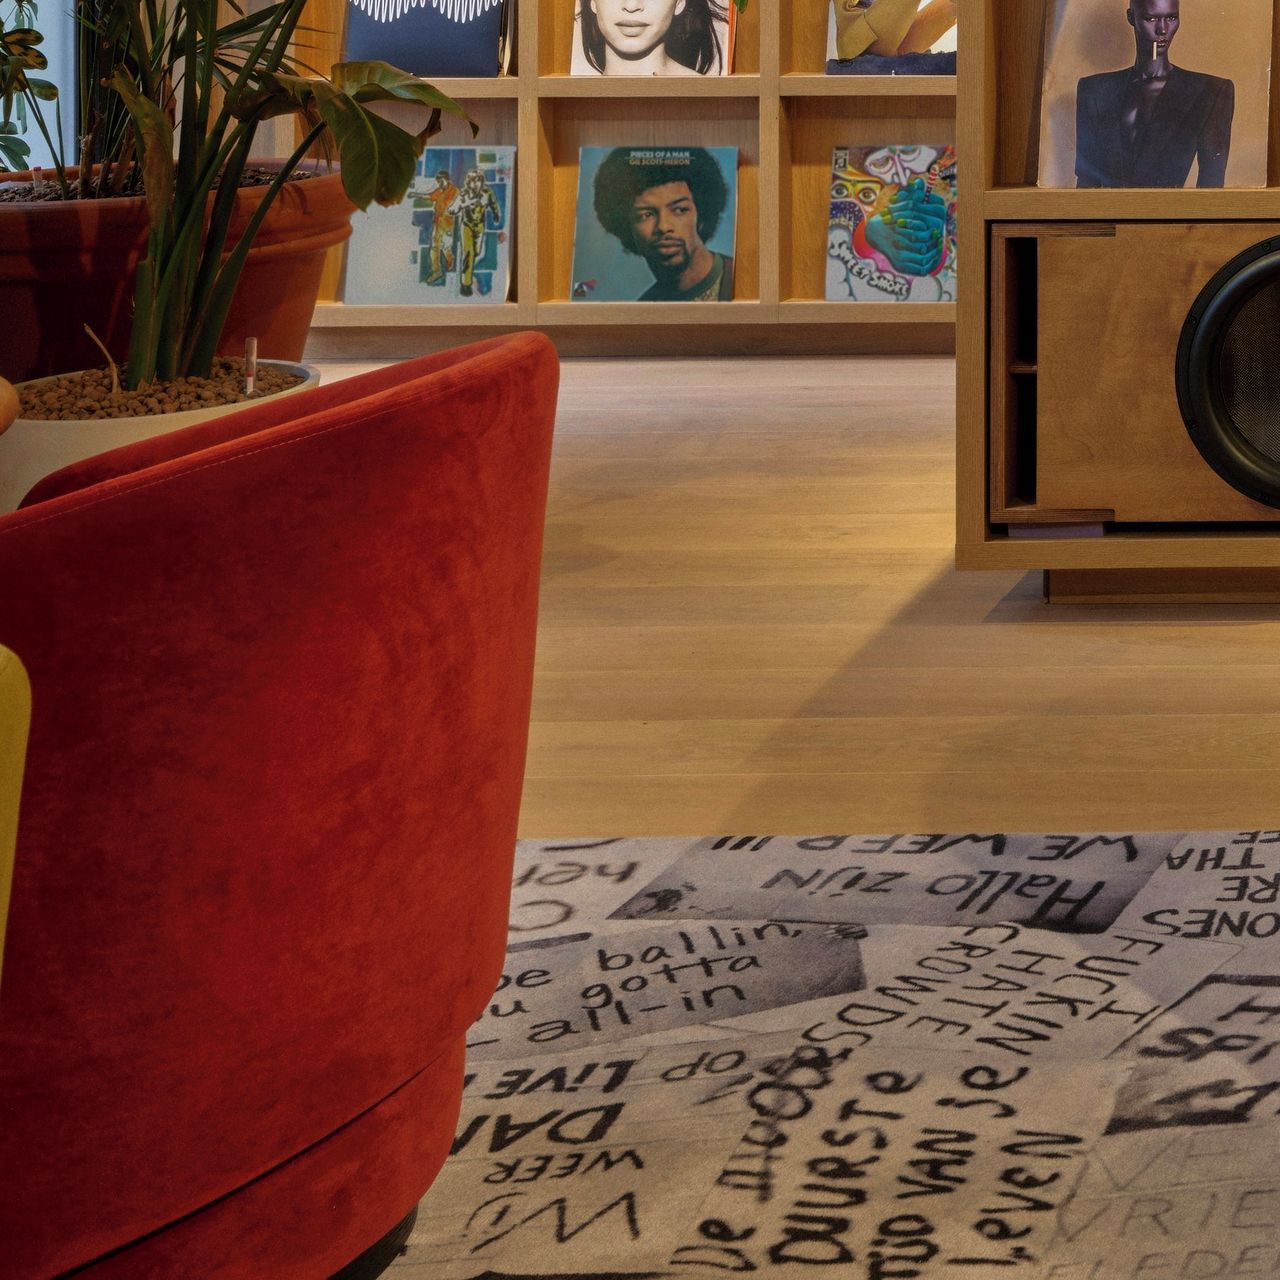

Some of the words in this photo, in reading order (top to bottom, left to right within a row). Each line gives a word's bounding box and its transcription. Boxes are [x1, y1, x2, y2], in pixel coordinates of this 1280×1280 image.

[868, 274, 910, 297] SMOKE
[924, 869, 1106, 924] Hallo
[907, 948, 1066, 1036] HATE
[482, 1150, 645, 1184] WEER
